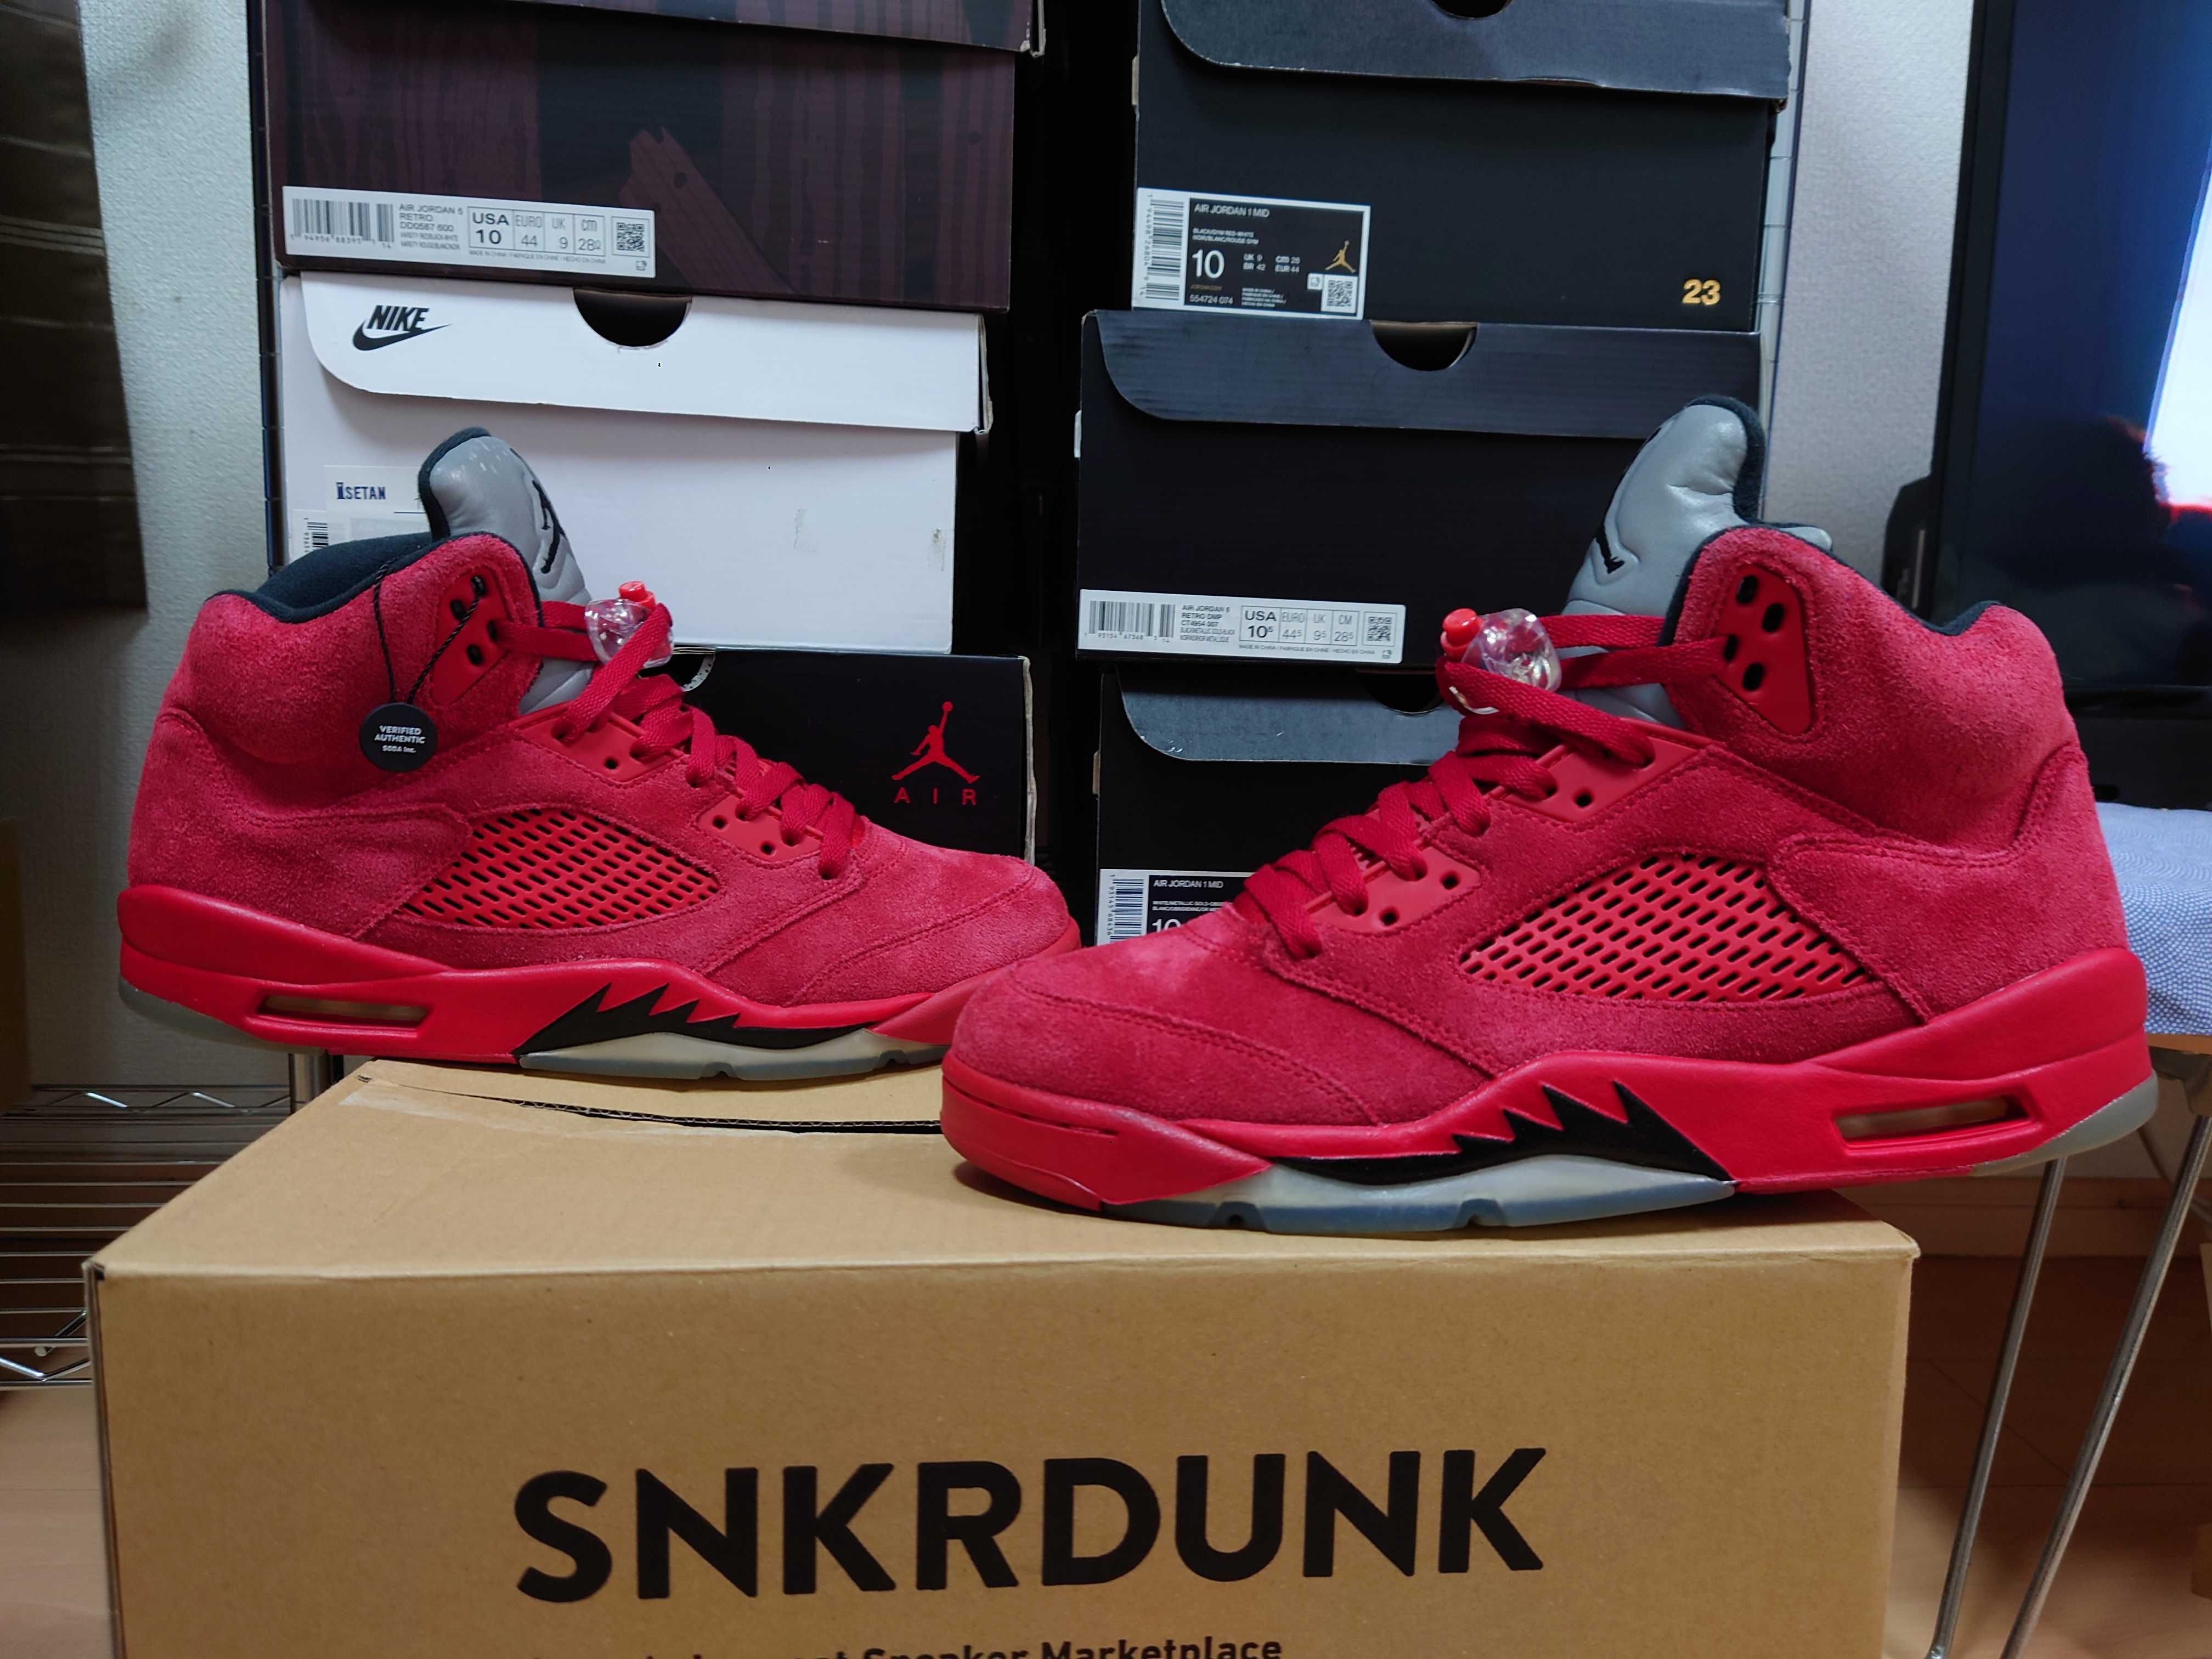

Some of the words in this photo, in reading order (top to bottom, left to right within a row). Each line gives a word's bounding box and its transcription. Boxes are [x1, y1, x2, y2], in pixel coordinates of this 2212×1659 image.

[399, 203, 414, 211] AIR
[418, 205, 455, 215] JORDAN
[458, 207, 464, 216] 5
[1194, 203, 1209, 213] AIR
[1210, 205, 1247, 216] JORDAN
[1248, 208, 1252, 216] 1
[1252, 208, 1270, 218] MID
[399, 212, 433, 222] RETRO
[472, 212, 510, 225] USA
[515, 215, 541, 228] EURO
[551, 217, 567, 229] UK
[437, 223, 454, 232] 600
[476, 229, 502, 245] 10
[521, 235, 538, 246] 44
[559, 236, 569, 249] 9
[1192, 249, 1224, 278] 10
[1274, 264, 1290, 273] EUR
[1682, 278, 1721, 305] 23
[1189, 294, 1218, 303] 554724
[367, 304, 430, 331] NIKE
[1245, 610, 1277, 622] USA
[1282, 611, 1305, 623] EURO
[1313, 613, 1325, 624] UK
[1338, 614, 1352, 625] CM
[379, 725, 422, 735] VERIFIED
[374, 733, 426, 744] AUTHENTIC
[894, 787, 977, 805] AIR
[515, 1448, 1545, 1603] SNKRDUNK
